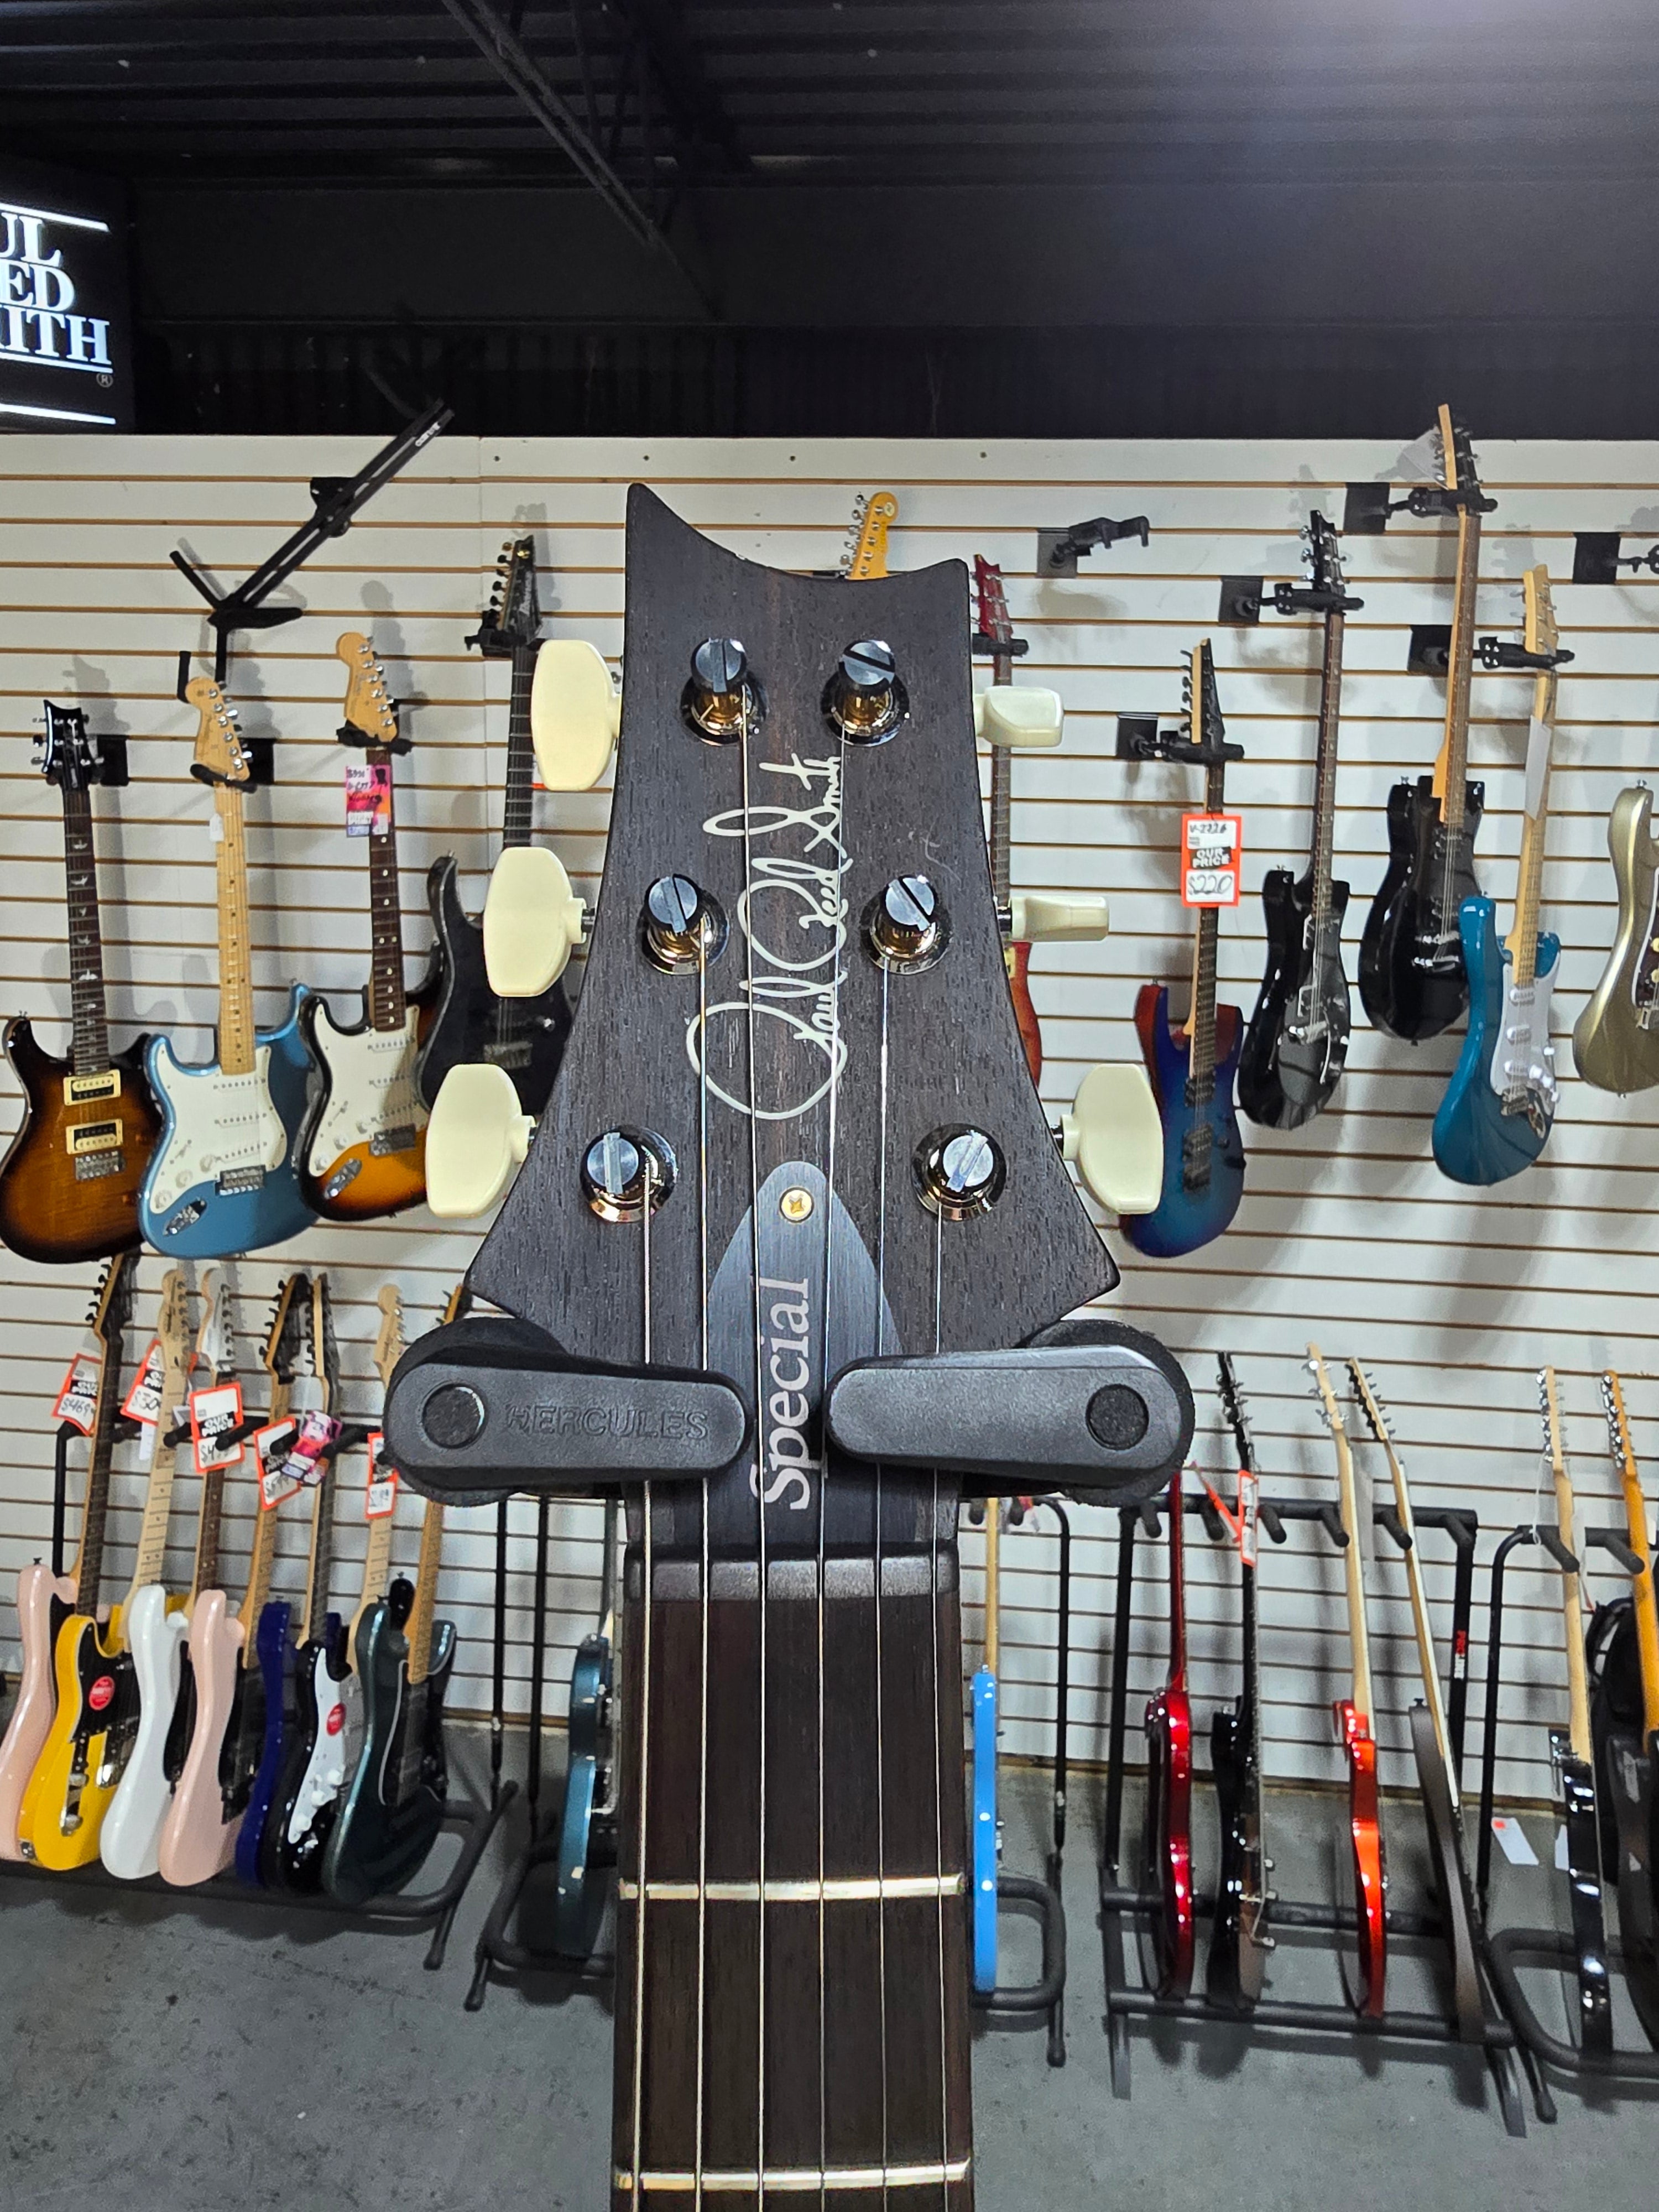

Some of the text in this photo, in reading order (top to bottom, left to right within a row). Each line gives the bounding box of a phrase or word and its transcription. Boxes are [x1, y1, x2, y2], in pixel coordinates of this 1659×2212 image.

[0, 305, 112, 364] ITH
[1192, 854, 1230, 868] PRICE
[1196, 847, 1224, 858] OUR
[1188, 875, 1233, 895] $220
[686, 753, 853, 1119] Paul Reed Smith
[749, 1278, 828, 1510] Special
[505, 1404, 708, 1438] HERCULES
